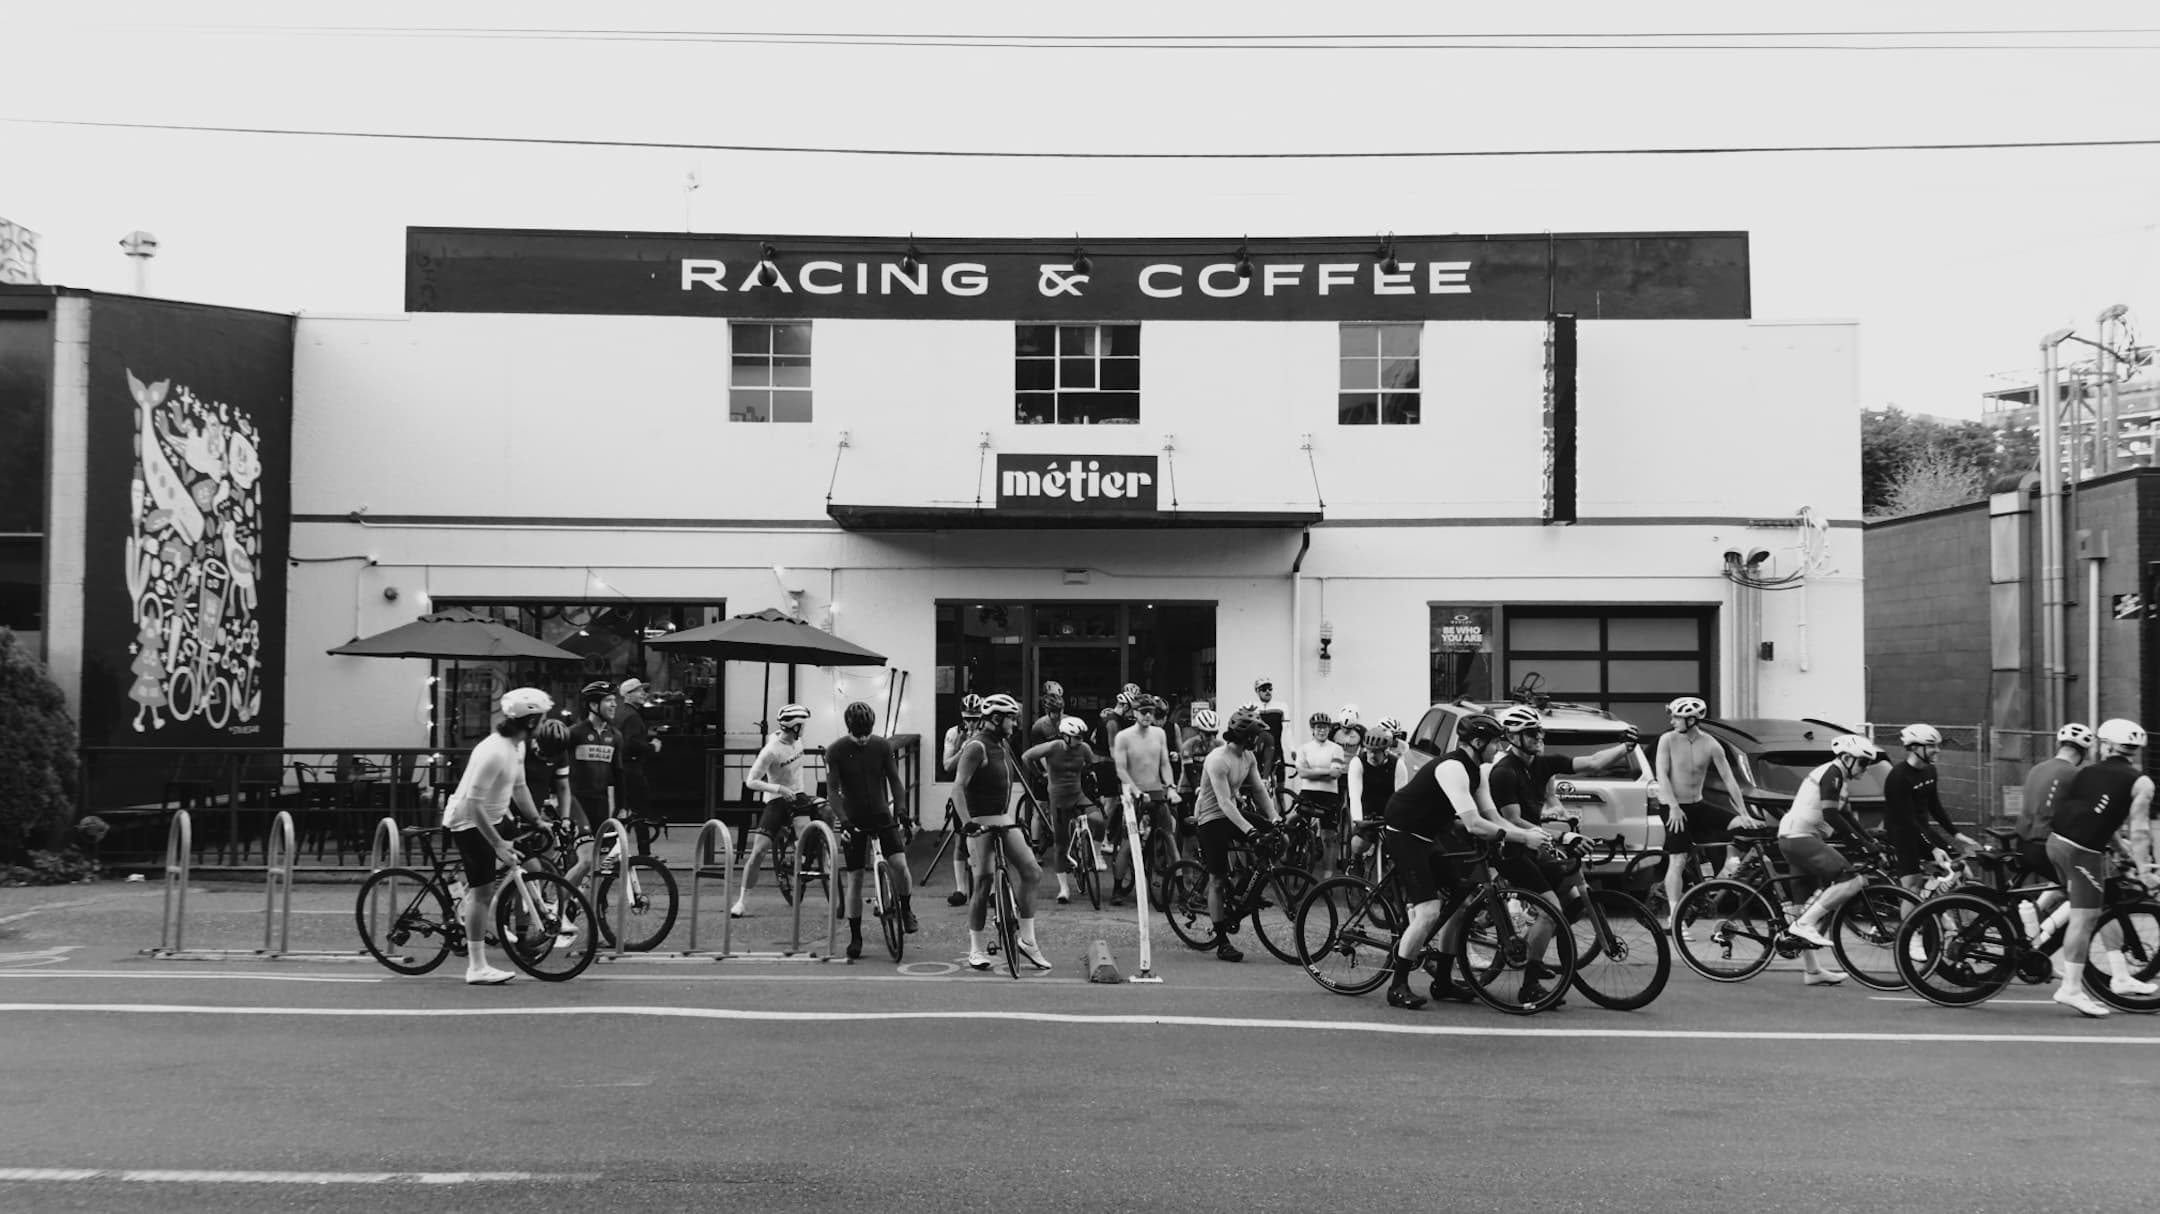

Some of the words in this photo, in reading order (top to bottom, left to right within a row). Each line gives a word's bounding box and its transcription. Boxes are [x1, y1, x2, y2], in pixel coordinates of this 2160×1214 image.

[682, 258, 988, 297] RACING
[1038, 263, 1090, 297] &
[1139, 261, 1472, 298] COFFEE
[1002, 460, 1152, 502] métier
[1443, 626, 1455, 634] BE
[1456, 626, 1481, 634] WHO
